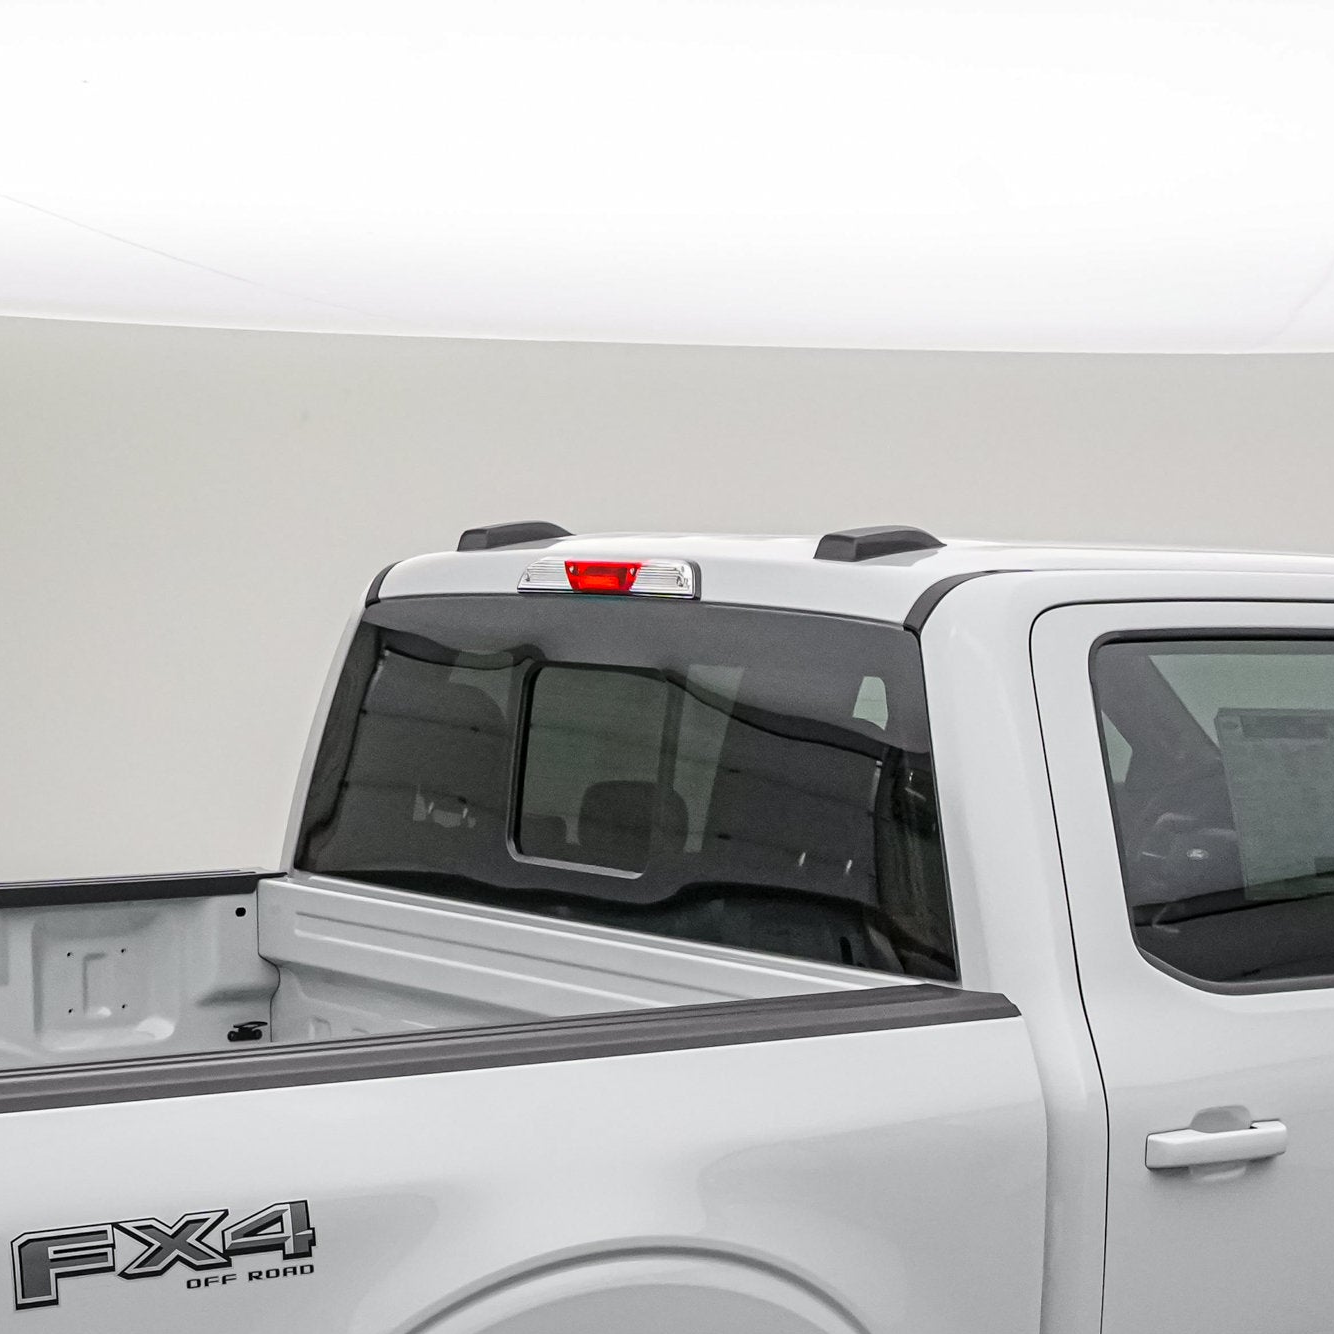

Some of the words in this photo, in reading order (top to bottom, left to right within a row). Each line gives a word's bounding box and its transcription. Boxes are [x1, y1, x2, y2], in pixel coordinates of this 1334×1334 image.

[10, 1199, 316, 1312] FX4
[186, 1273, 237, 1290] OFF
[248, 1264, 315, 1282] ROAD
